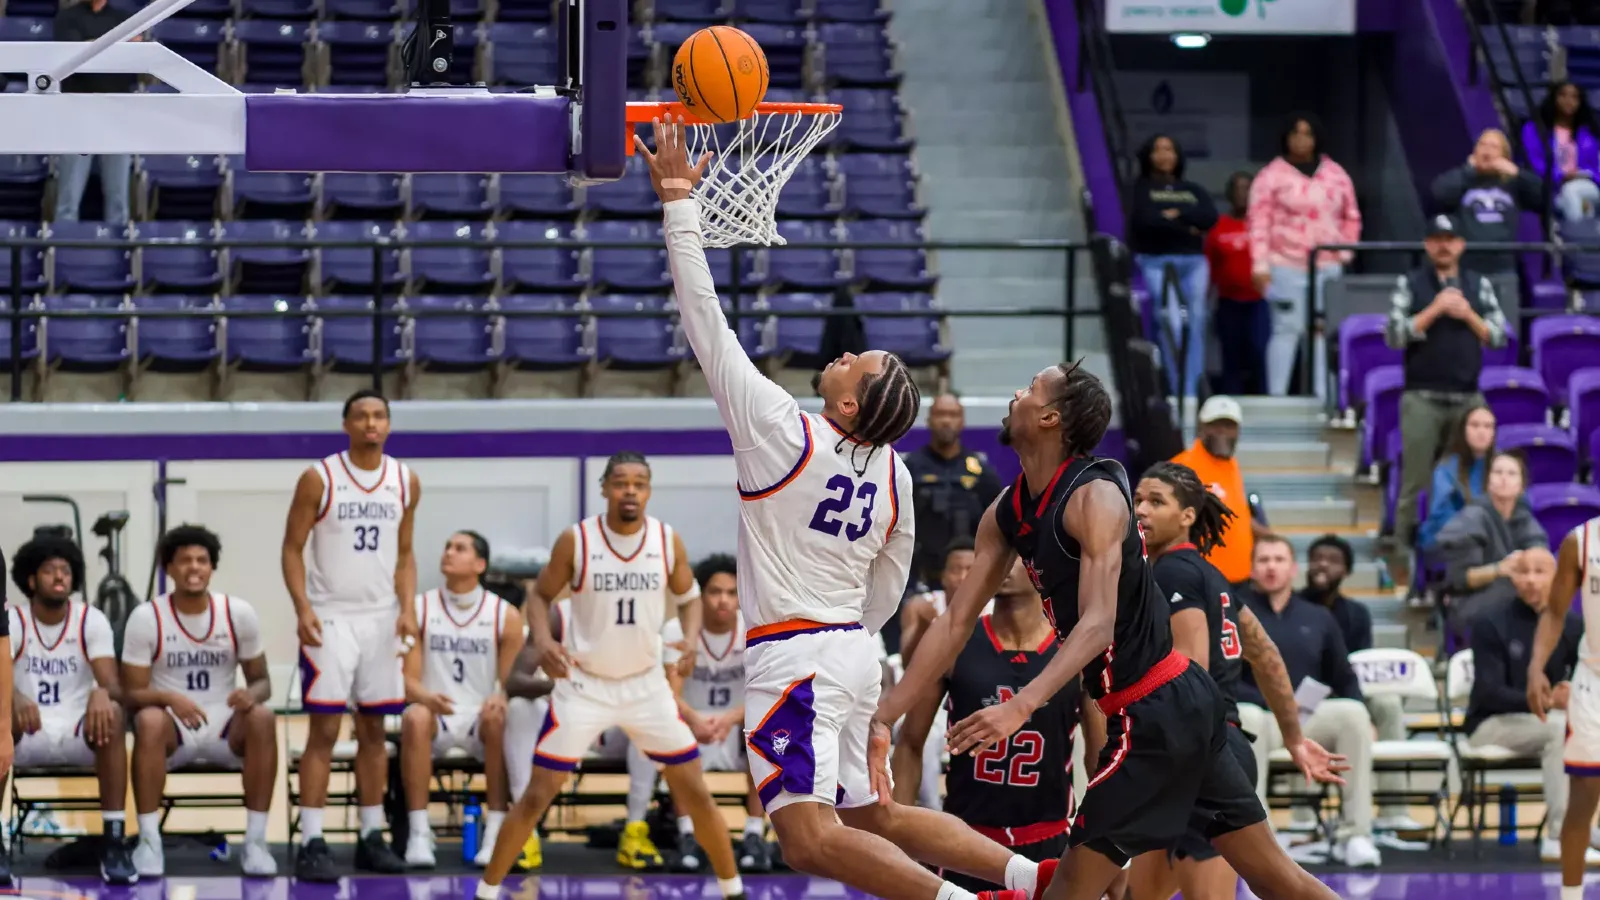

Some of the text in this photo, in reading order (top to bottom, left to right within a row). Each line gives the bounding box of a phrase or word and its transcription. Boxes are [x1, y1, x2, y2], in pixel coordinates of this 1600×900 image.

[675, 63, 696, 107] NCAA
[338, 502, 396, 520] DEMONS
[808, 473, 878, 542] 23
[353, 525, 379, 551] 33
[593, 572, 660, 592] DEMONS
[615, 597, 636, 625] 11
[1220, 592, 1242, 659] 5
[429, 634, 489, 654] DEMONS
[186, 670, 210, 691] 10
[453, 658, 464, 684] 3
[1352, 660, 1415, 683] NSU
[38, 680, 60, 706] 21
[708, 687, 731, 706] 13
[974, 731, 1045, 786] 22
